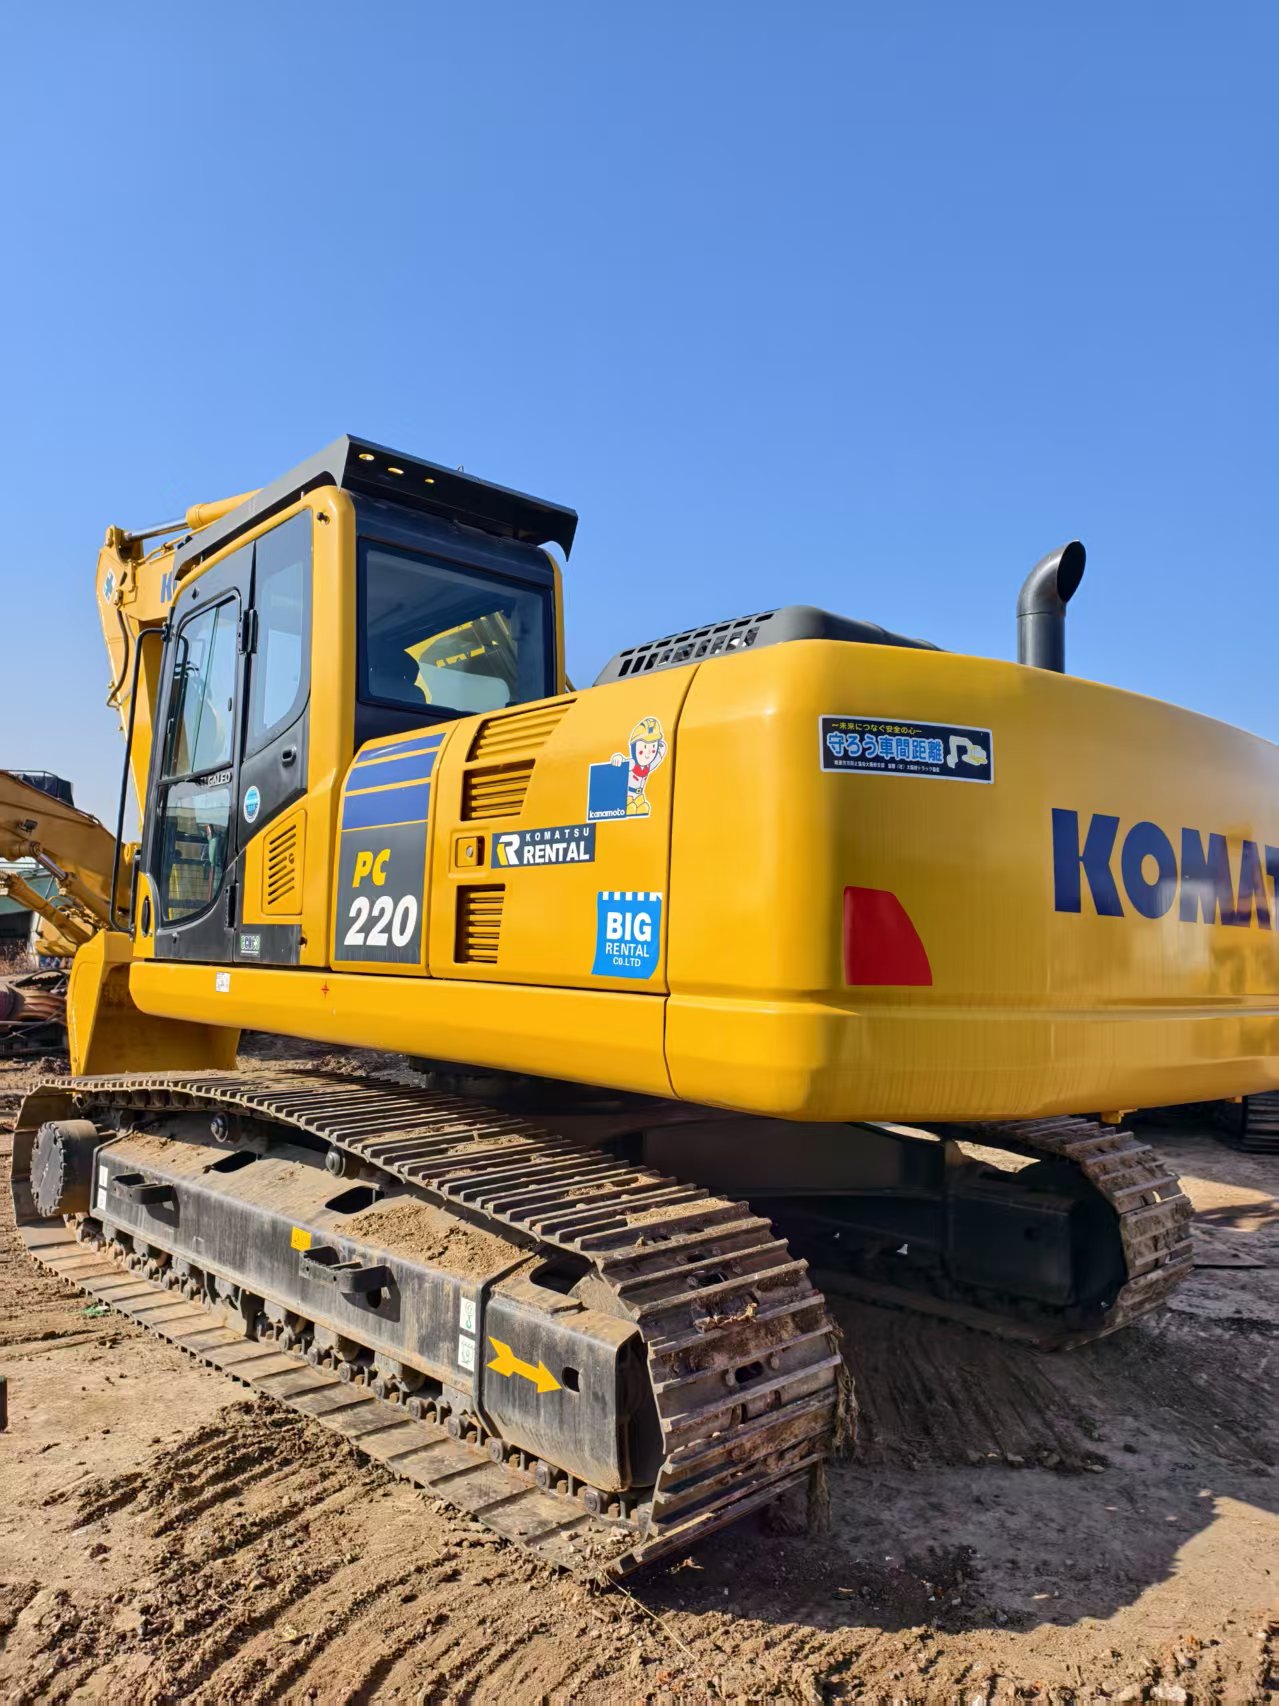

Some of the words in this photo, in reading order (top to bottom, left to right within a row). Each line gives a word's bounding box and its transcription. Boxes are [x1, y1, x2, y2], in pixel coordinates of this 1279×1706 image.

[827, 731, 944, 764] 守ろう車間距離
[207, 771, 231, 786] GALEO
[589, 807, 625, 818] kanamoto
[525, 827, 590, 842] KOMATSU
[523, 841, 590, 864] RENTAL
[352, 848, 391, 888] PC
[343, 894, 418, 947] 220
[606, 911, 652, 942] BIG
[605, 941, 650, 958] RENTAL
